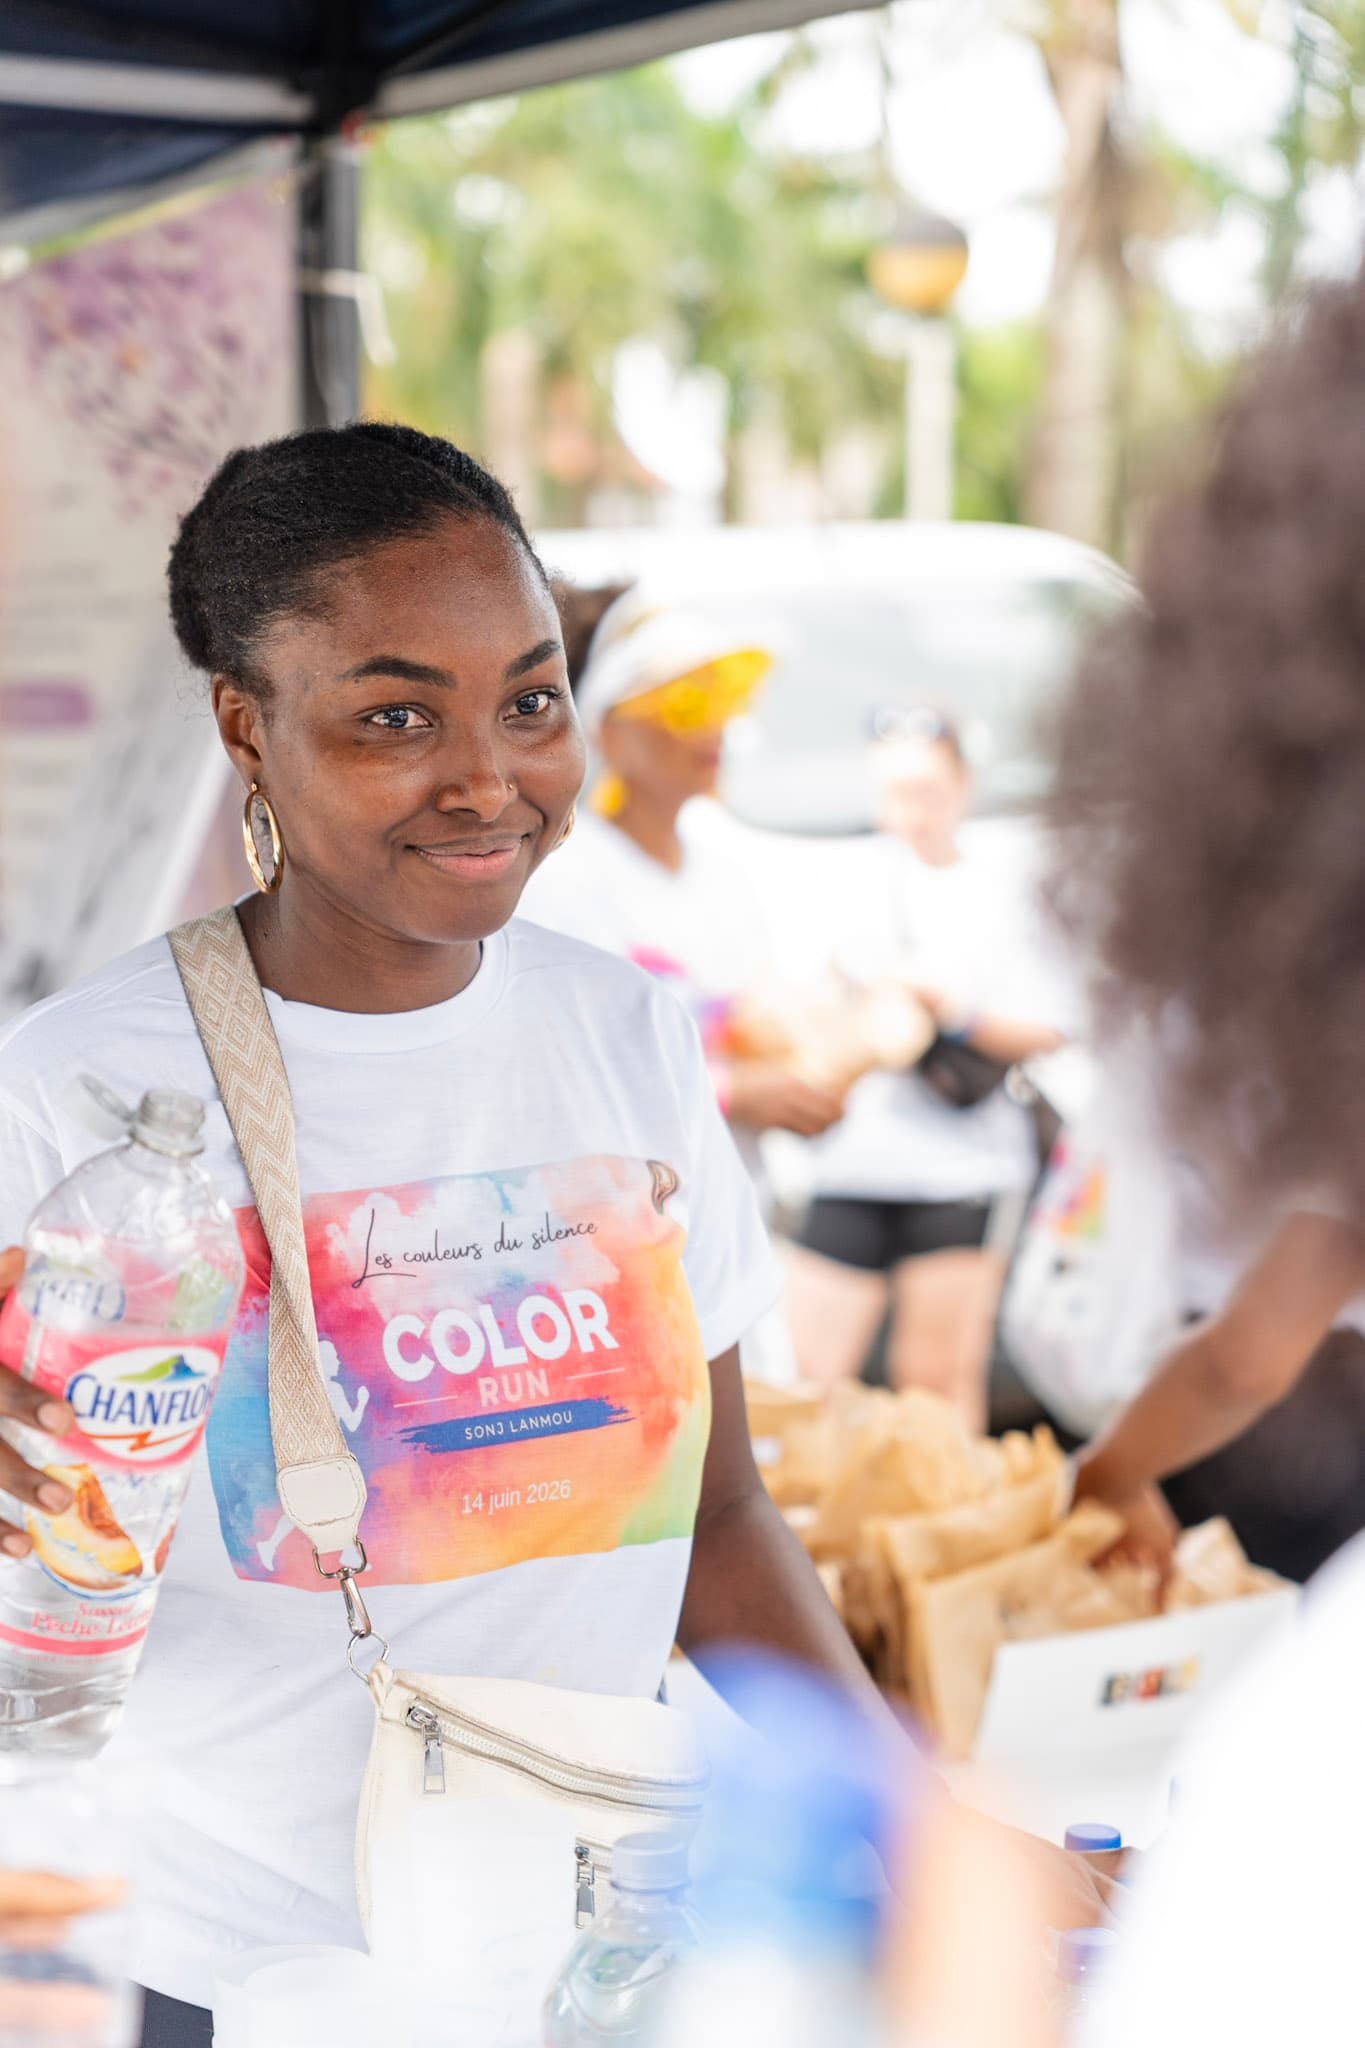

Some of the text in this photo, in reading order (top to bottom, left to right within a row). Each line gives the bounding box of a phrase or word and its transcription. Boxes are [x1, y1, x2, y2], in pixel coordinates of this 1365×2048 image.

[352, 1208, 597, 1288] Les couleurs du silence
[382, 1289, 619, 1382] COLOR
[478, 1368, 549, 1407] RUN
[464, 1410, 573, 1440] SONJ LANMOU
[462, 1479, 571, 1515] 14 juin 2026
